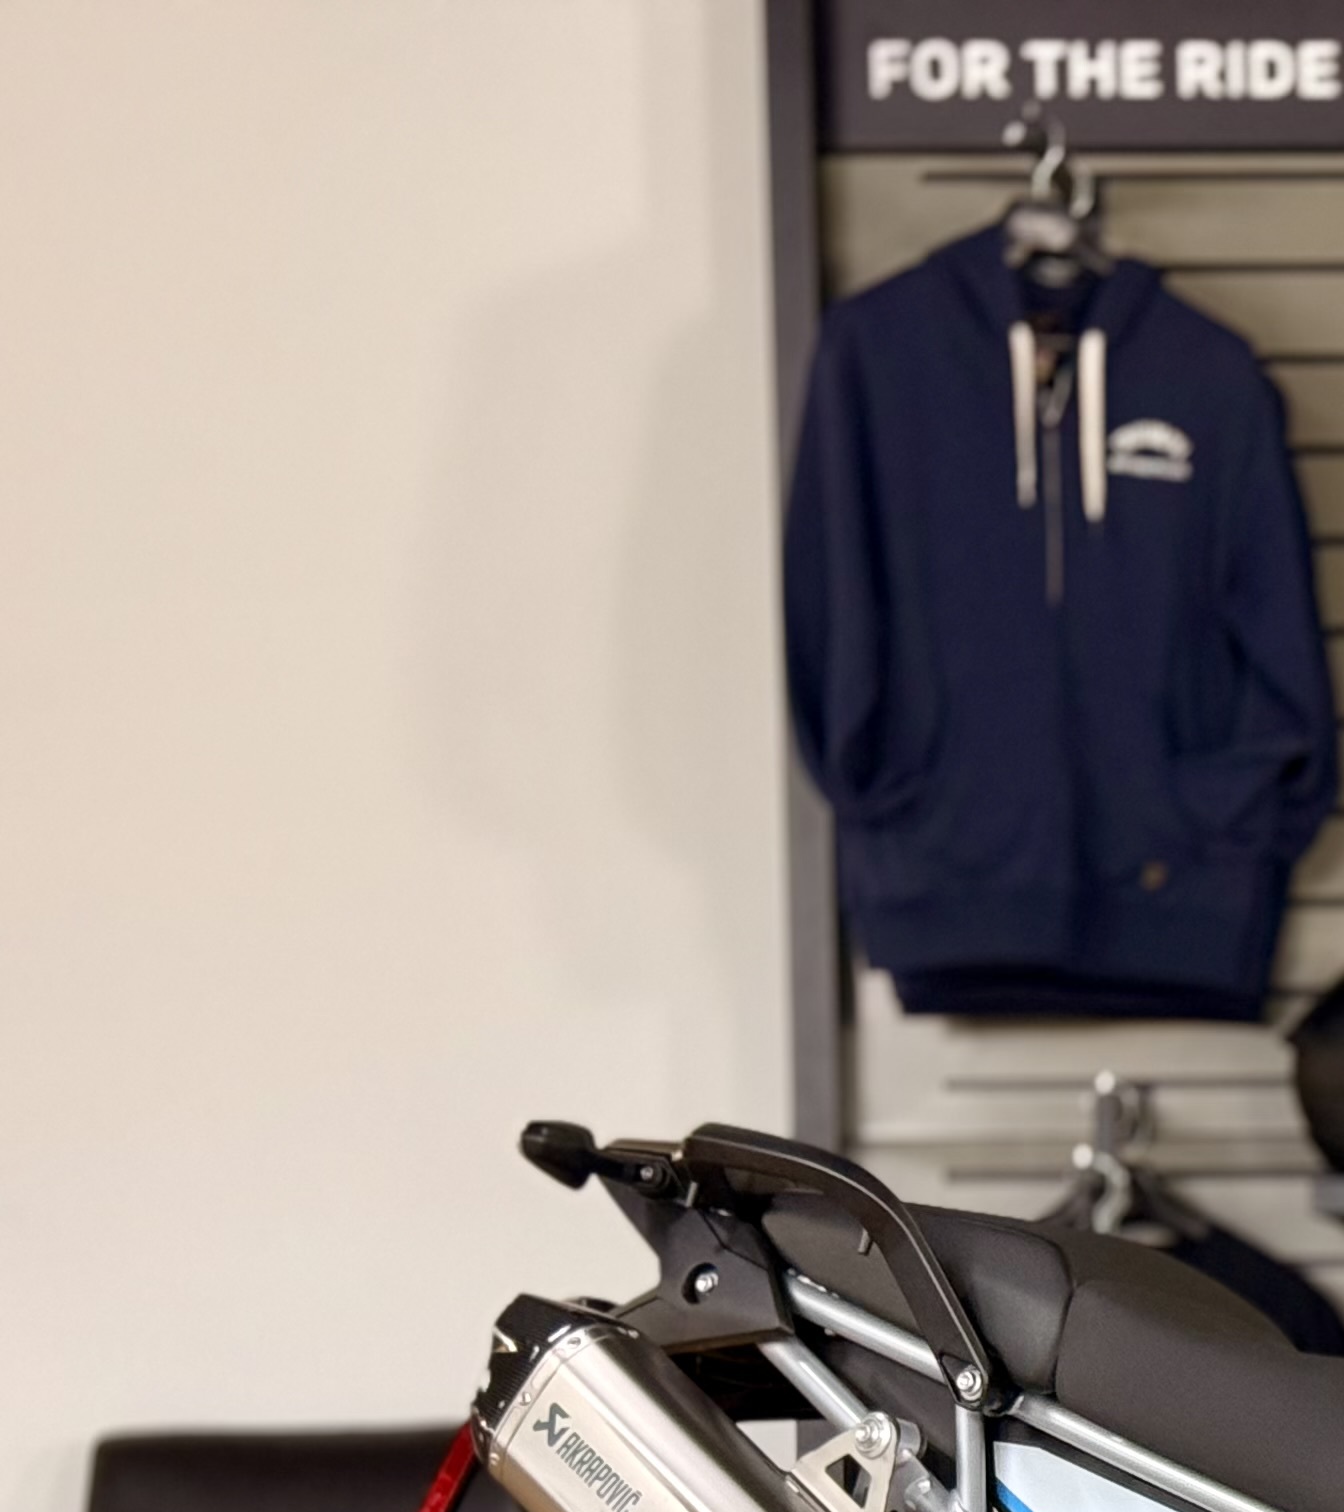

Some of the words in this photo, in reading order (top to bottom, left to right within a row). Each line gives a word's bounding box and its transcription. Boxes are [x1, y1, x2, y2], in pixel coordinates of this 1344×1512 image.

[867, 38, 1011, 99] FOR
[1020, 39, 1163, 99] THE
[1176, 39, 1342, 99] RIDE
